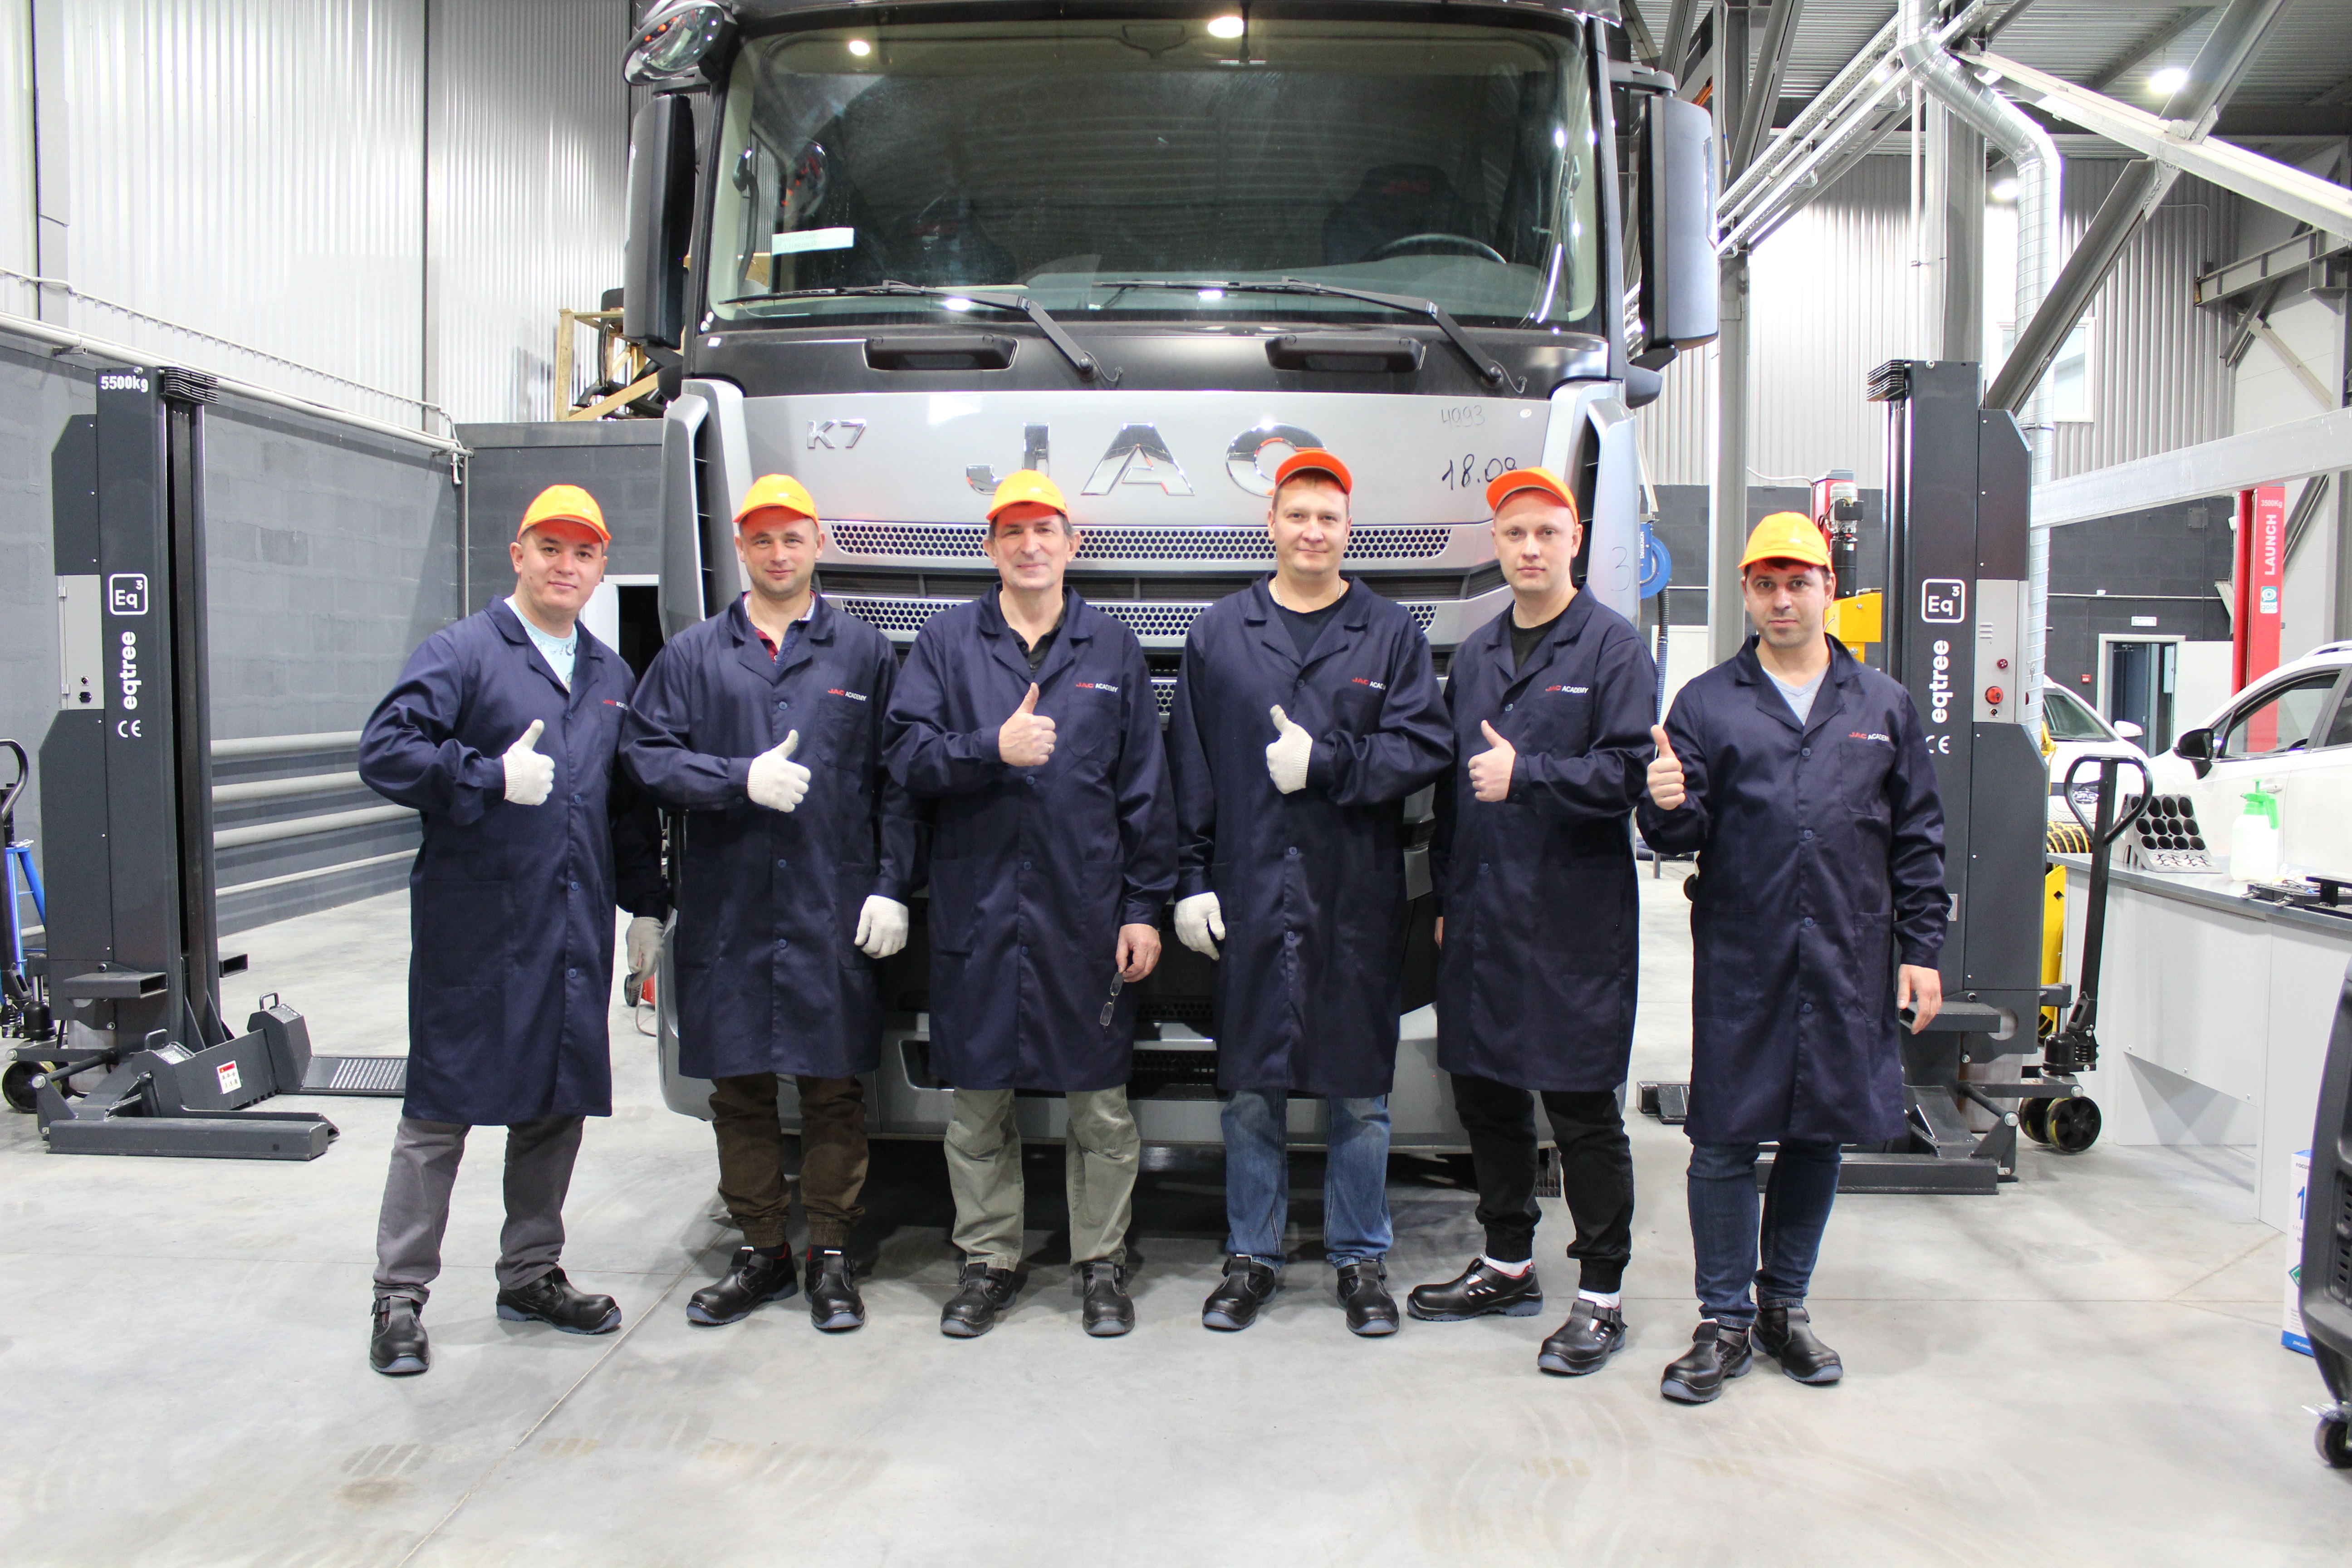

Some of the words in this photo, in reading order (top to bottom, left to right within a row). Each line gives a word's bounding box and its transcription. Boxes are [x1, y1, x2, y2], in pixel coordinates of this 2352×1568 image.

[101, 375, 149, 393] 5500kg
[807, 418, 867, 449] K7
[966, 421, 1328, 498] JAC
[2261, 500, 2283, 508] 3500Kg
[2264, 514, 2277, 575] LAUNCH
[120, 631, 142, 710] eqtree
[1929, 640, 1954, 723] eqtree
[845, 691, 867, 701] ACADEMY
[1095, 683, 1118, 692] ACADEMY
[1561, 686, 1589, 694] ACADEMY
